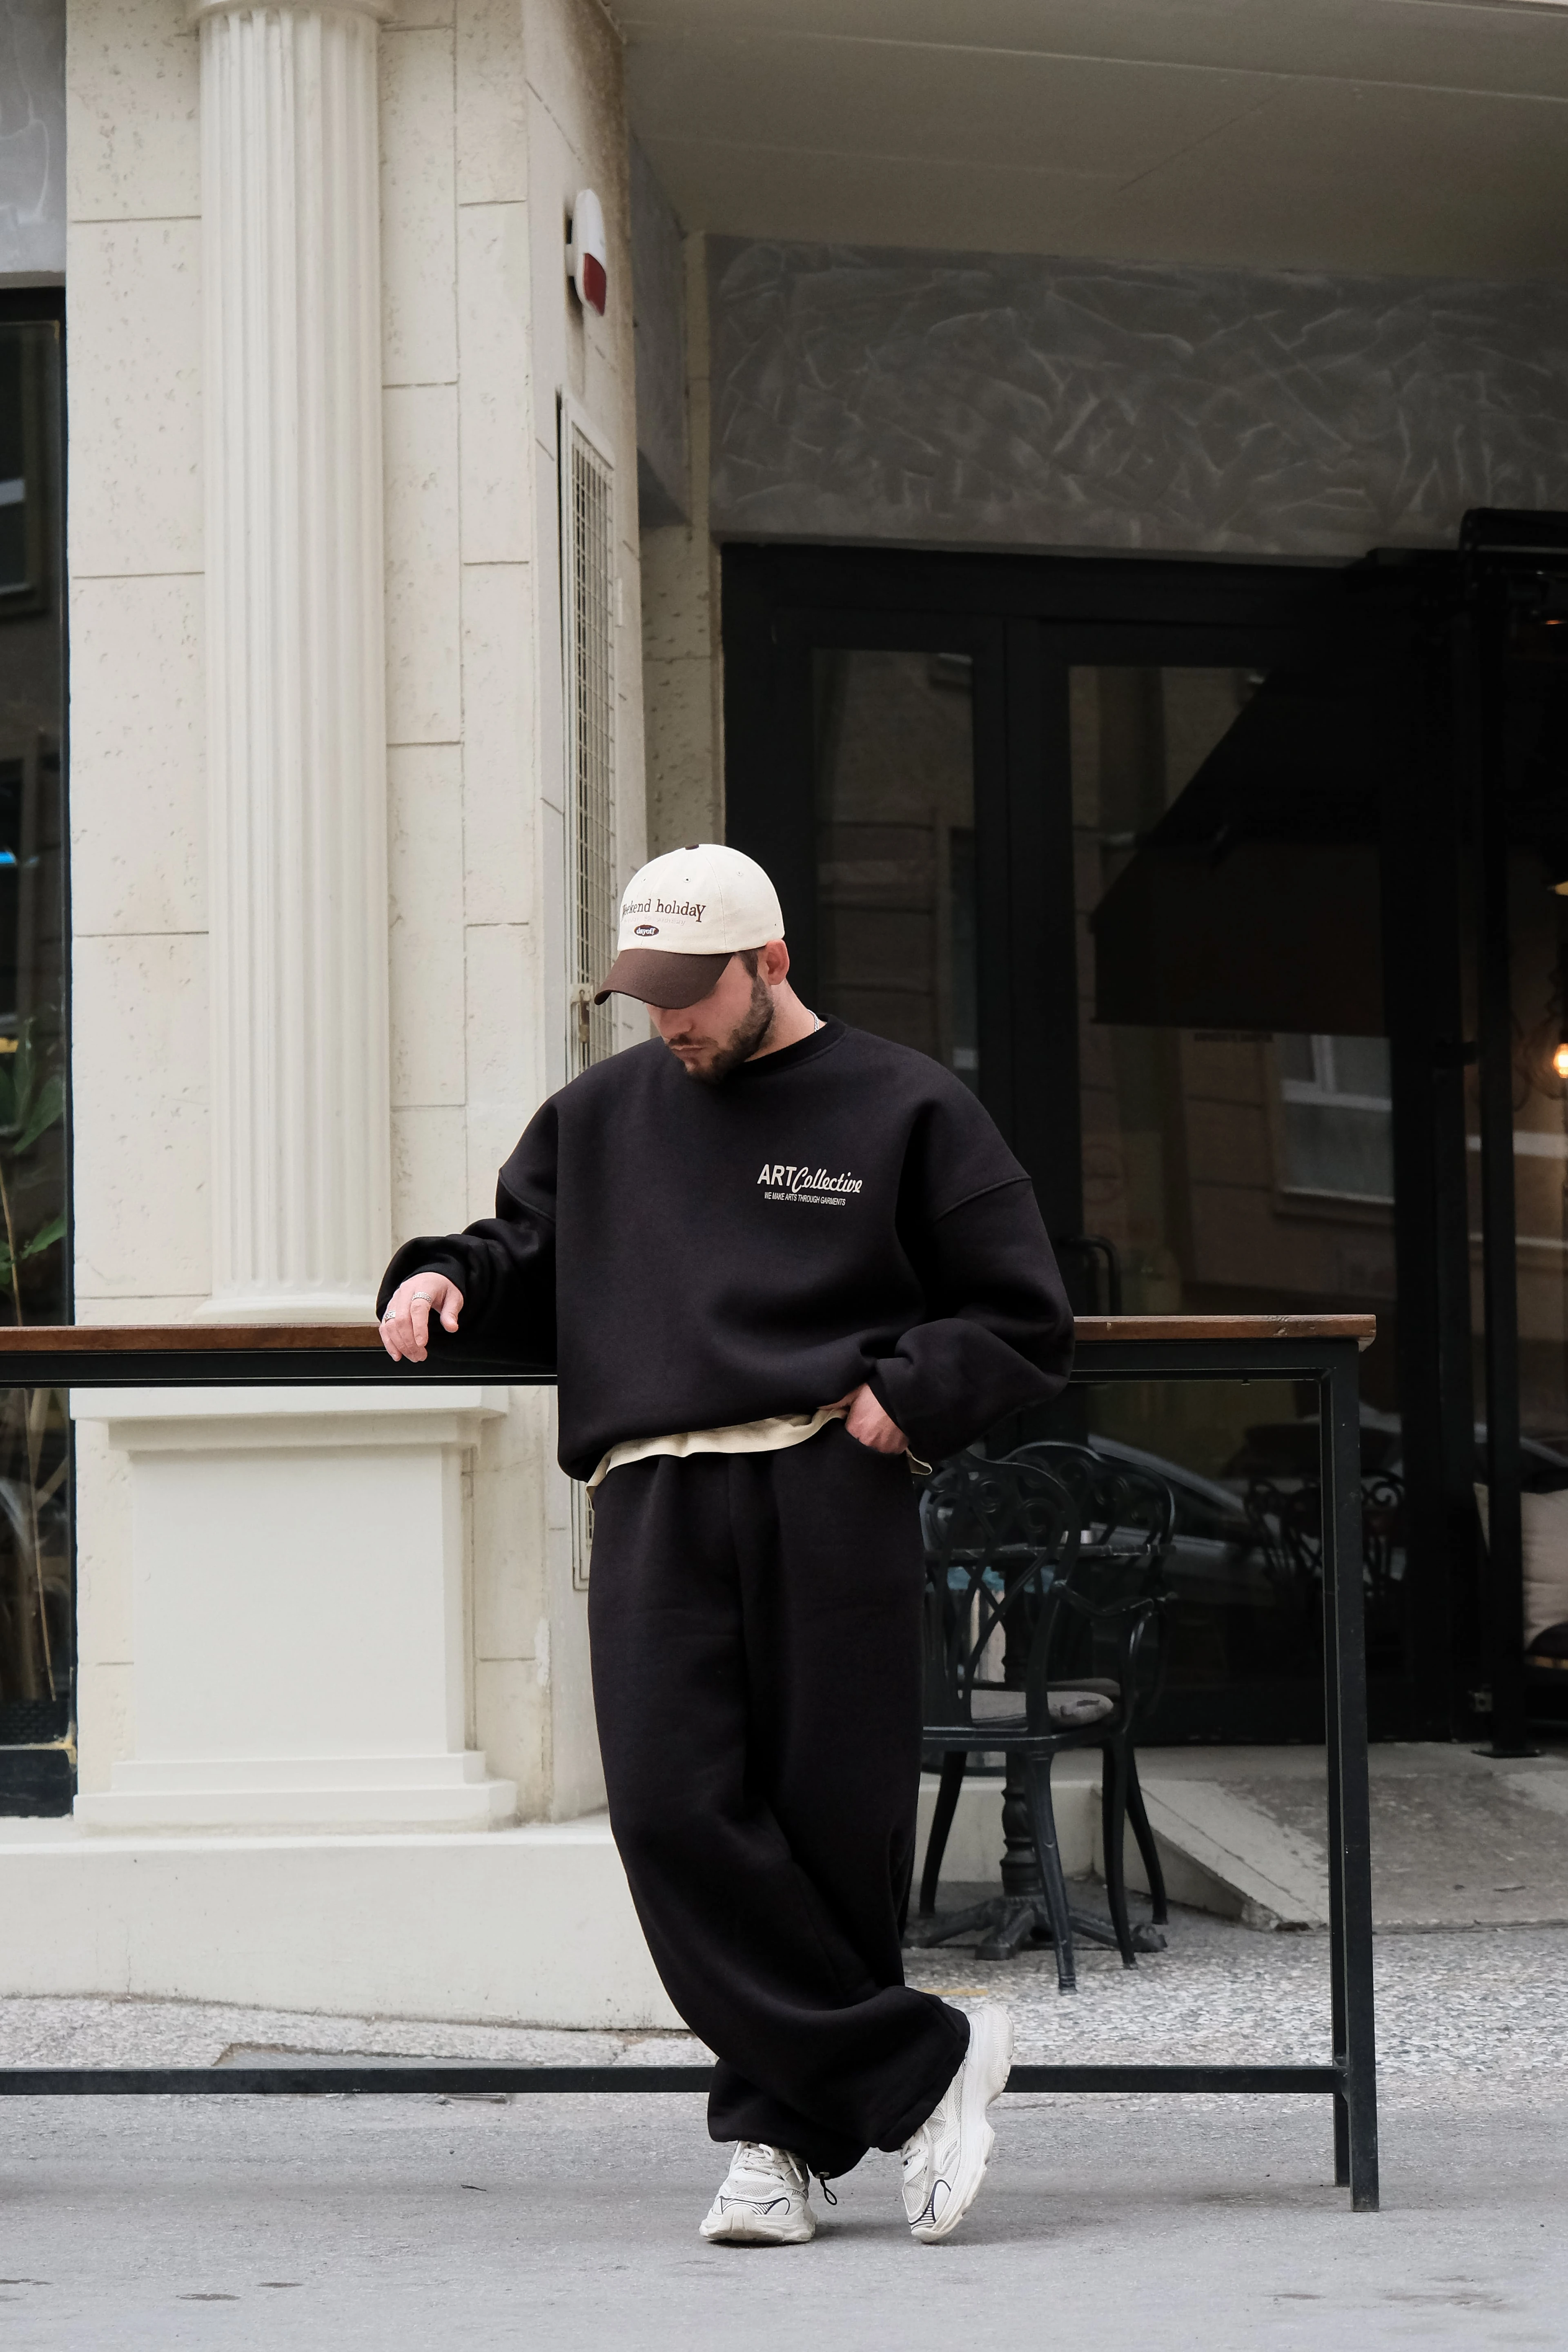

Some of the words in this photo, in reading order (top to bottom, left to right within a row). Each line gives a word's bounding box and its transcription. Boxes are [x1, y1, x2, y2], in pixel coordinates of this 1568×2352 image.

[764, 1192, 772, 1200] WE
[772, 1192, 785, 1200] MAKE
[785, 1194, 797, 1202] ARTS
[798, 1194, 820, 1204] THROUGH
[820, 1196, 846, 1206] GARMENTS
